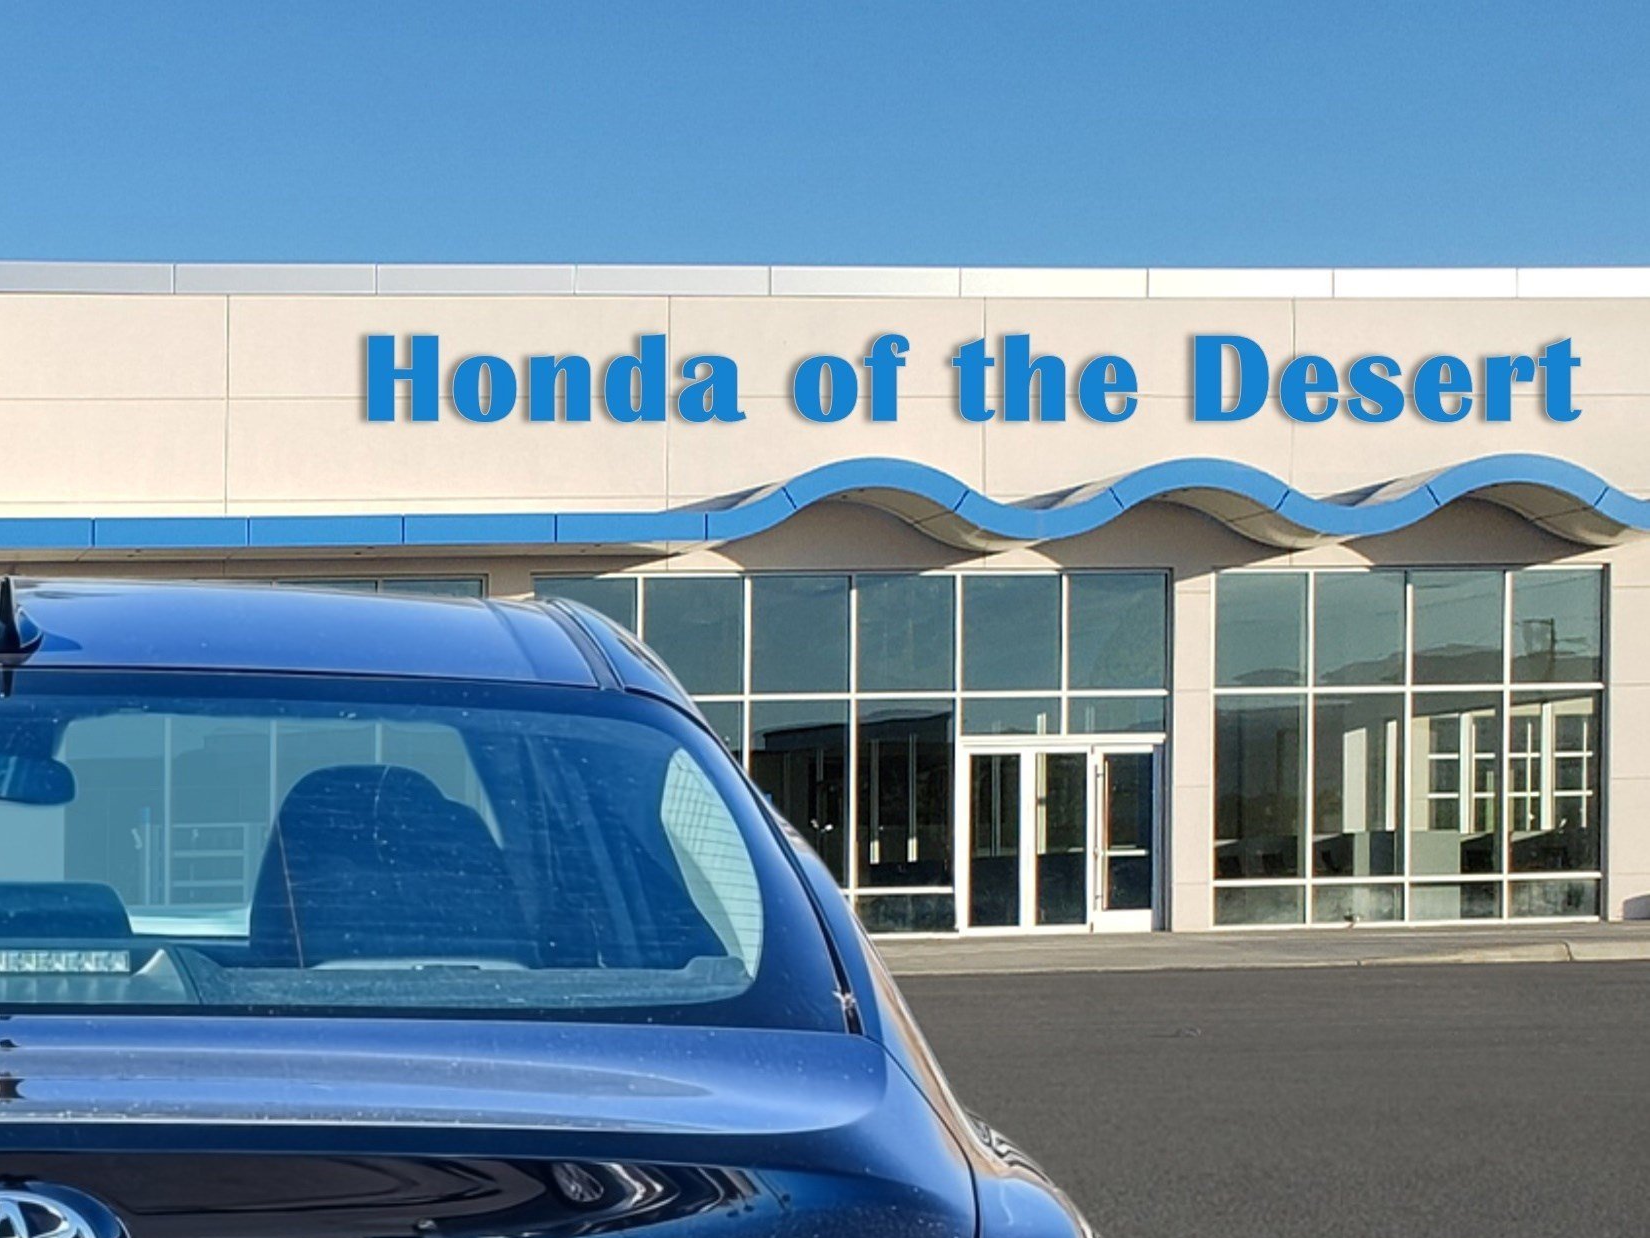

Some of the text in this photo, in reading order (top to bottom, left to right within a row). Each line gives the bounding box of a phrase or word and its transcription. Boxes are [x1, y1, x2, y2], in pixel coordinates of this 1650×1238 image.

[363, 333, 1583, 423] Honda of the Desert
